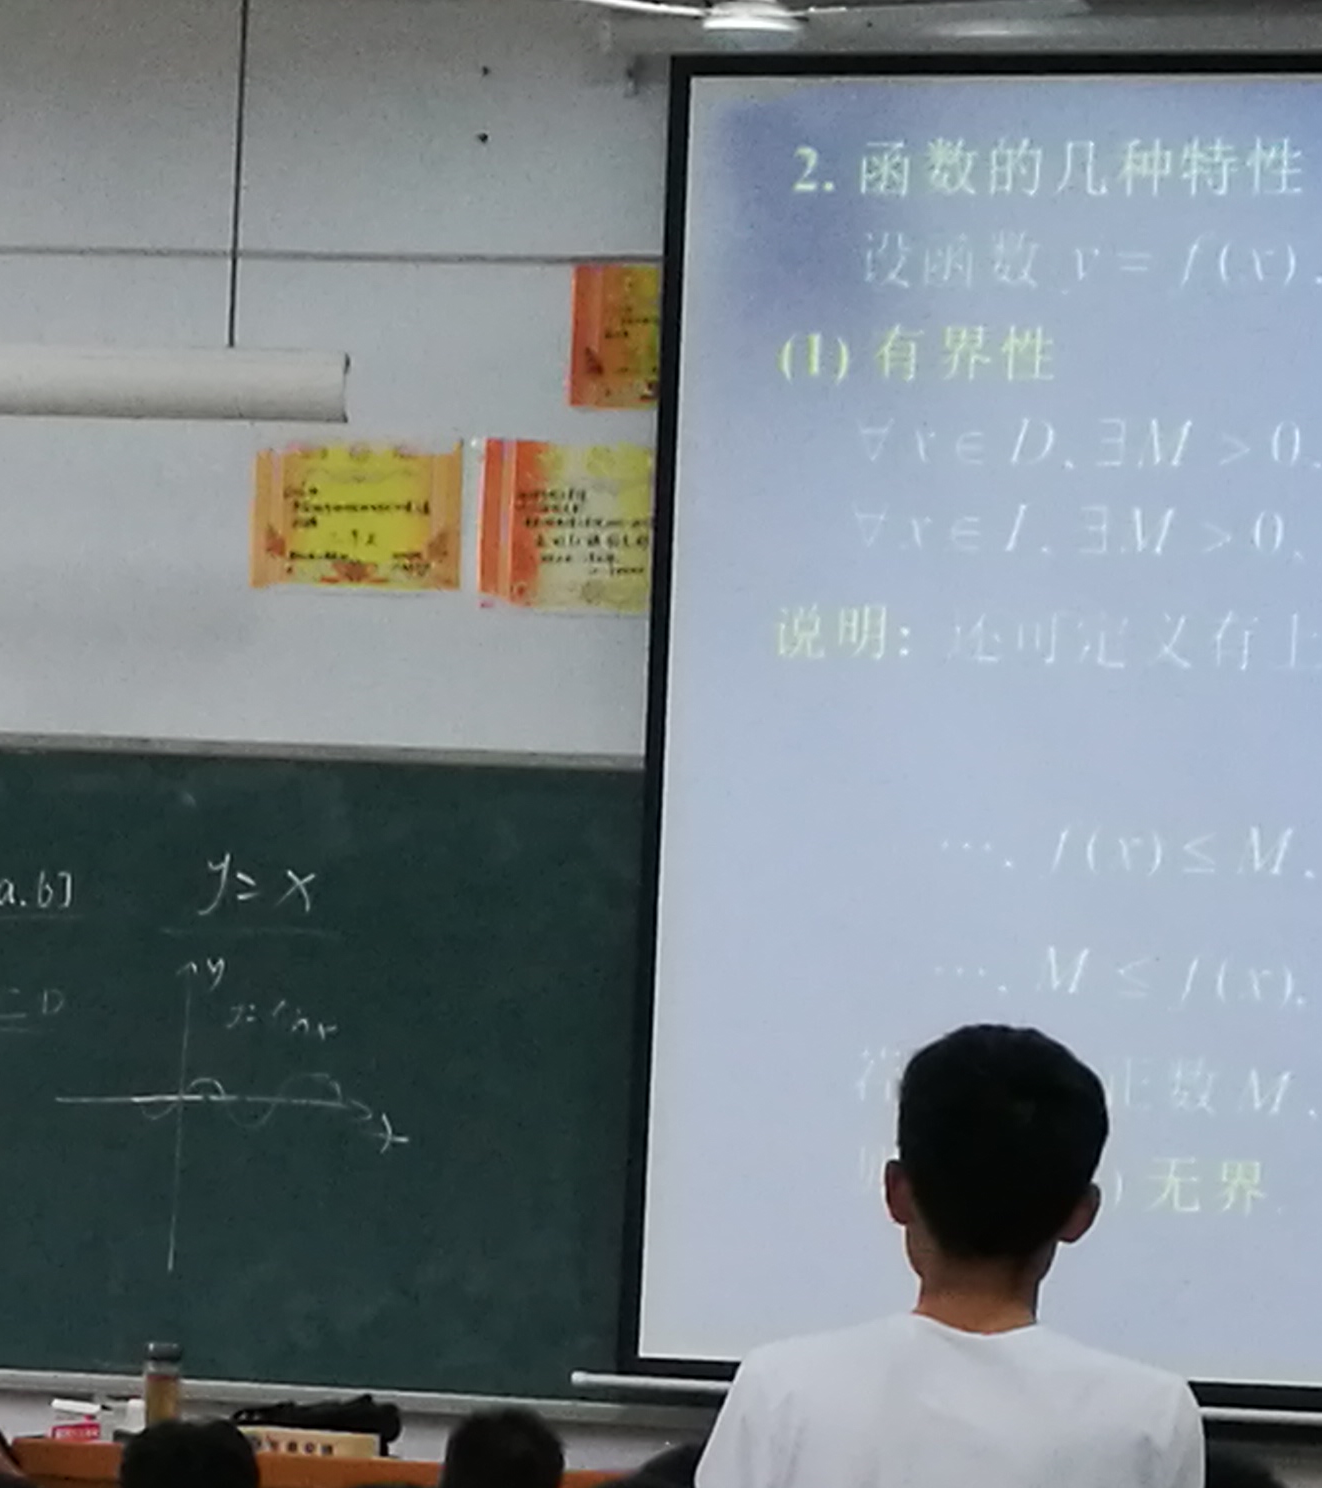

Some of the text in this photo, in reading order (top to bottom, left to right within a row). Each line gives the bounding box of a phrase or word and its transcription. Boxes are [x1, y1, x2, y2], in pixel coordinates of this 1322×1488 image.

[858, 136, 1305, 198] 函数的几种特性
[873, 323, 1056, 384] 有界性
